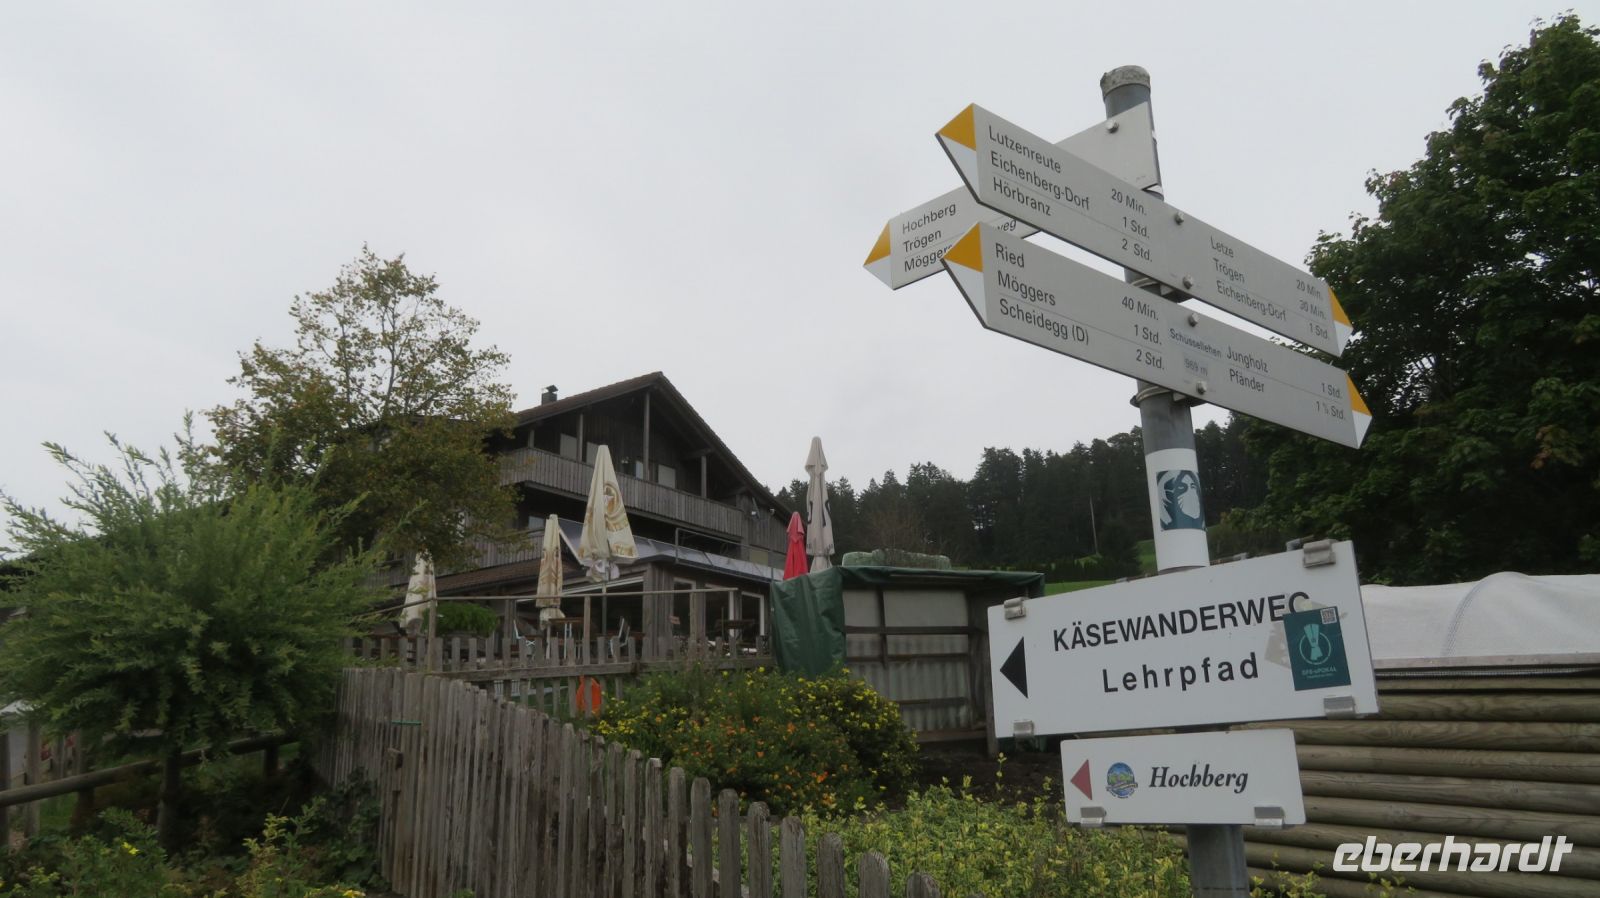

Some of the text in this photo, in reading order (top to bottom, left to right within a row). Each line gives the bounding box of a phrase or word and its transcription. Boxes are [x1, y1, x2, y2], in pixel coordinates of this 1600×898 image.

[989, 125, 1147, 215] Lutzenreute 20 Min.
[991, 151, 1090, 210] Eichenberg-Dorf
[1131, 219, 1150, 239] Std.
[902, 203, 957, 234] Hochberg
[903, 229, 942, 253] Trögen
[993, 177, 1152, 263] Hörbranz 2 Std.
[995, 242, 1159, 321] Ried 40 Min.
[1210, 236, 1324, 301] Letze 20 Min.
[1213, 258, 1327, 320] Trögen 30 Min.
[998, 270, 1056, 306] Möggers
[1142, 327, 1162, 345] Std.
[1216, 280, 1287, 321] Eichenberg-Dorf
[1000, 298, 1165, 370] Scheidegg (D) 2 Std.
[1226, 345, 1268, 373] Jungholz
[1328, 384, 1343, 399] Std.
[1229, 368, 1265, 393] Pfänder
[1331, 405, 1346, 420] Std.
[1103, 652, 1258, 693] Lehrpfad
[1149, 764, 1248, 794] Hochberg
